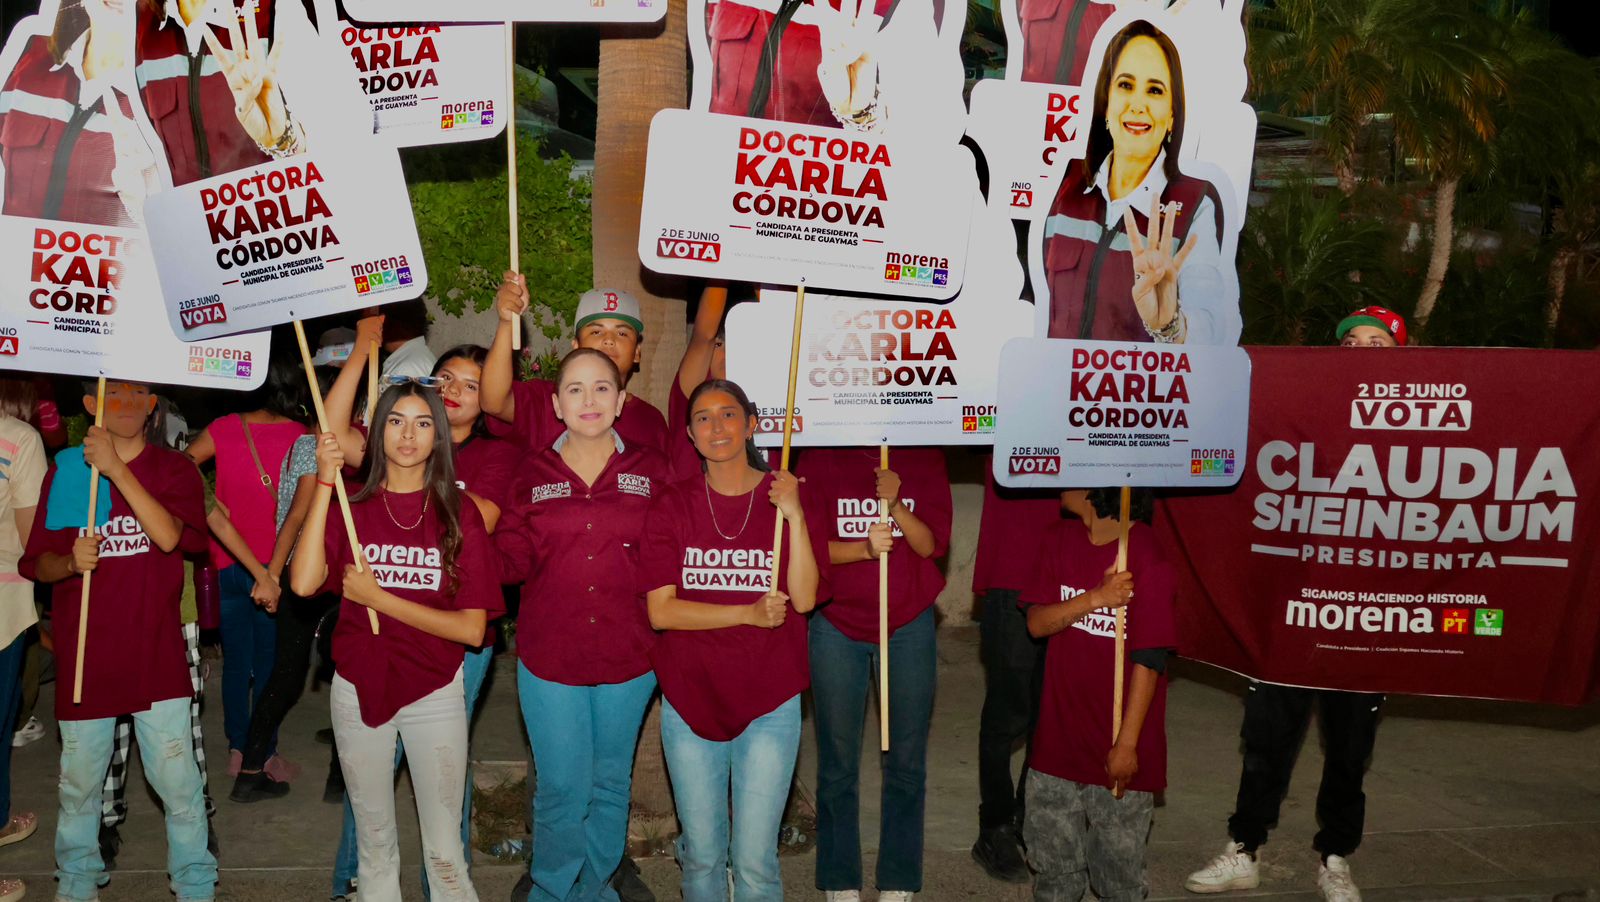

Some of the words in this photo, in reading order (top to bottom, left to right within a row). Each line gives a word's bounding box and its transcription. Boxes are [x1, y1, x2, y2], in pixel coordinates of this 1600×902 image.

[341, 26, 441, 46] OCTORA
[351, 36, 440, 73] ARLA
[359, 68, 439, 95] RDOVA
[380, 94, 418, 104] PRESIDENTA
[385, 100, 418, 110] GUAYMAS
[441, 99, 494, 114] morena
[442, 119, 453, 128] PT
[738, 127, 892, 167] DOCTORA
[200, 161, 324, 211] DOCTORA
[734, 152, 889, 202] KARLA
[206, 187, 333, 244] KARLA
[732, 189, 885, 229] CÓRDOVA
[661, 228, 667, 237] 2
[670, 229, 685, 238] DE
[687, 231, 720, 241] JUNIO
[756, 221, 801, 232] CANDIDATA
[811, 227, 859, 238] PRESIDENTA
[756, 229, 802, 241] MUNICIPAL
[804, 234, 816, 242] DE
[818, 236, 858, 246] GUAYMAS
[34, 228, 123, 257] DOCT
[216, 225, 340, 270] CÓRDOVA
[660, 240, 718, 260] VOTA
[240, 263, 276, 279] CANDIDATA
[283, 255, 322, 270] PRESIDENTA
[351, 255, 408, 276] morena
[886, 252, 949, 269] morena
[31, 252, 122, 290] KAR
[243, 272, 279, 286] MUNICIPAL
[291, 263, 324, 276] GUAYMAS
[886, 270, 899, 279] PT
[357, 282, 368, 292] PT
[399, 271, 410, 279] PES
[29, 287, 118, 315] CÓRD
[179, 301, 185, 310] 2
[185, 299, 197, 308] DE
[198, 294, 220, 306] JUNIO
[604, 292, 618, 311] B
[54, 317, 101, 326] CANDIDATA
[181, 306, 224, 326] VOTA
[54, 325, 101, 334] MUNICIPAL
[189, 345, 252, 361] morena
[808, 331, 957, 362] KARLA
[1072, 348, 1192, 373] DOCTORA
[808, 363, 958, 387] CÓRDOVA
[1069, 371, 1190, 404] KARLA
[1358, 383, 1369, 398] 2
[1374, 383, 1401, 398] DE
[1405, 383, 1467, 398] JUNIO
[962, 405, 997, 416] mor
[1068, 403, 1189, 429] CÓRDOVA
[1355, 401, 1466, 428] VOTA
[759, 418, 800, 432] OTA
[964, 421, 976, 430] PT
[1012, 447, 1017, 455] 2
[1019, 447, 1031, 455] DE
[1032, 447, 1059, 455] JUNIO
[1191, 448, 1235, 459] morena
[1011, 458, 1058, 472] VOTA
[1192, 464, 1201, 473] PT
[1256, 439, 1578, 501] CLAUDIA
[532, 481, 570, 494] morena
[618, 473, 650, 482] DOCTORA
[618, 477, 650, 489] KARLA
[1252, 492, 1576, 544] SHEINBAUM
[359, 544, 441, 567] orena
[1301, 545, 1496, 570] PRESIDENTA
[373, 569, 434, 585] AYMAS
[1301, 588, 1356, 601] SIGAMOS
[1358, 592, 1425, 604] HACIENDO
[1427, 594, 1488, 605] HISTORIA
[1285, 600, 1434, 633] morena
[1443, 618, 1467, 633] PT
[1475, 627, 1502, 636] VERDE
